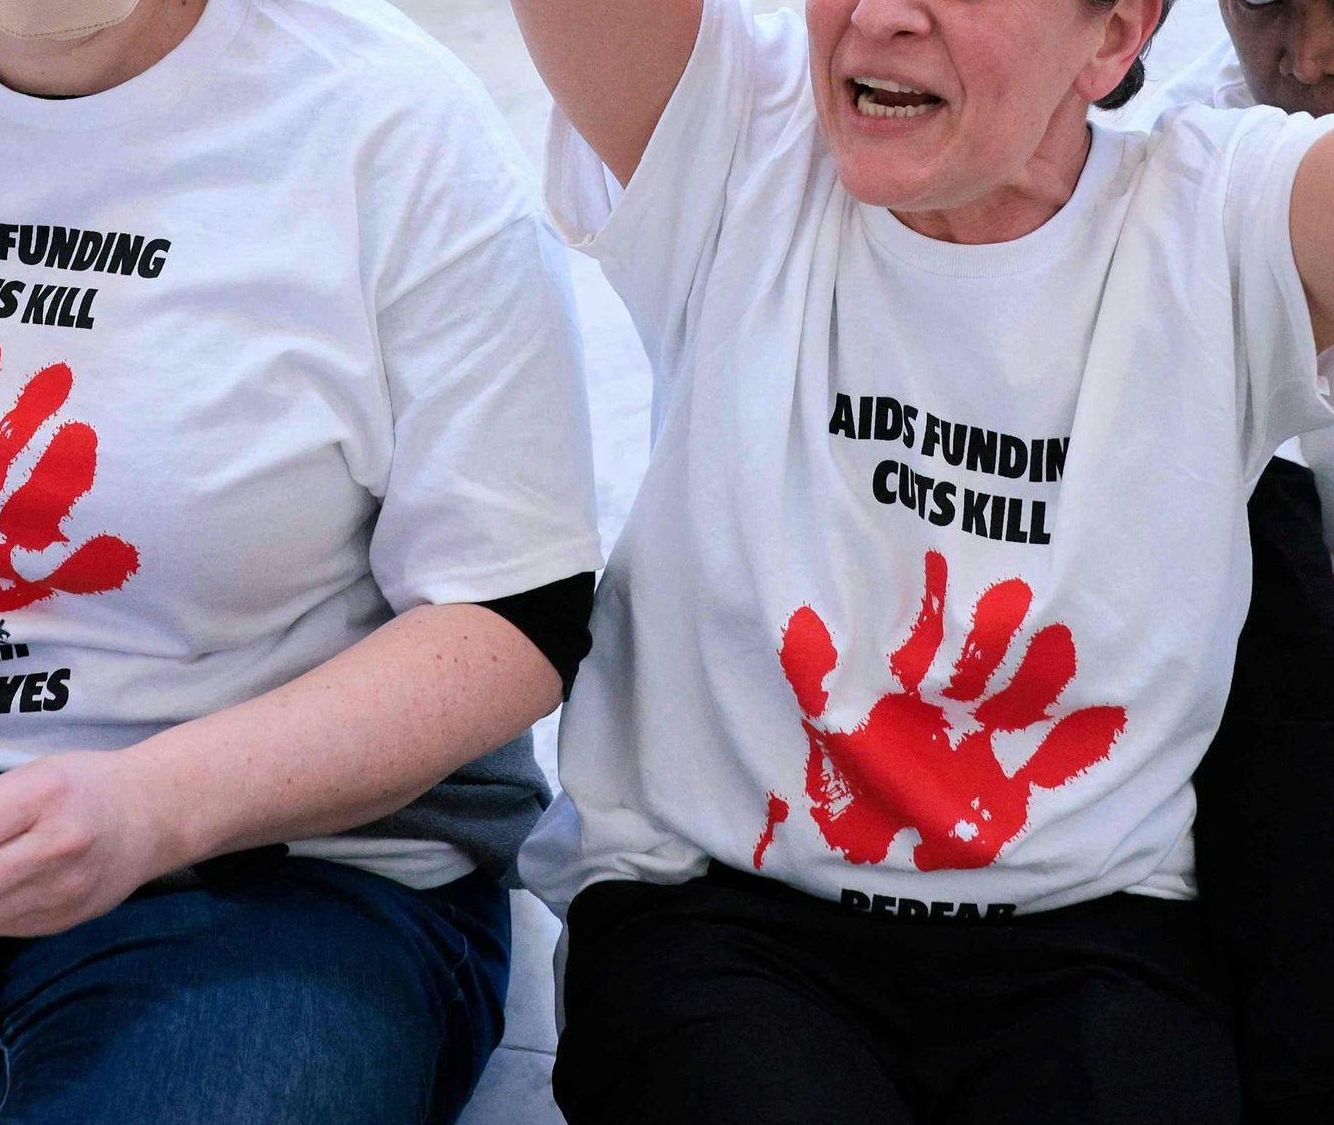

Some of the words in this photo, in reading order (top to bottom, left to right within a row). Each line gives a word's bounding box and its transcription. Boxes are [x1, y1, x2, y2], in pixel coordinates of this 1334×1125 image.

[20, 284, 99, 329] KILL
[828, 392, 919, 449] AIDS
[920, 412, 1071, 482] FUNDIN
[872, 460, 957, 526] CUTS
[961, 488, 1051, 545] KILL
